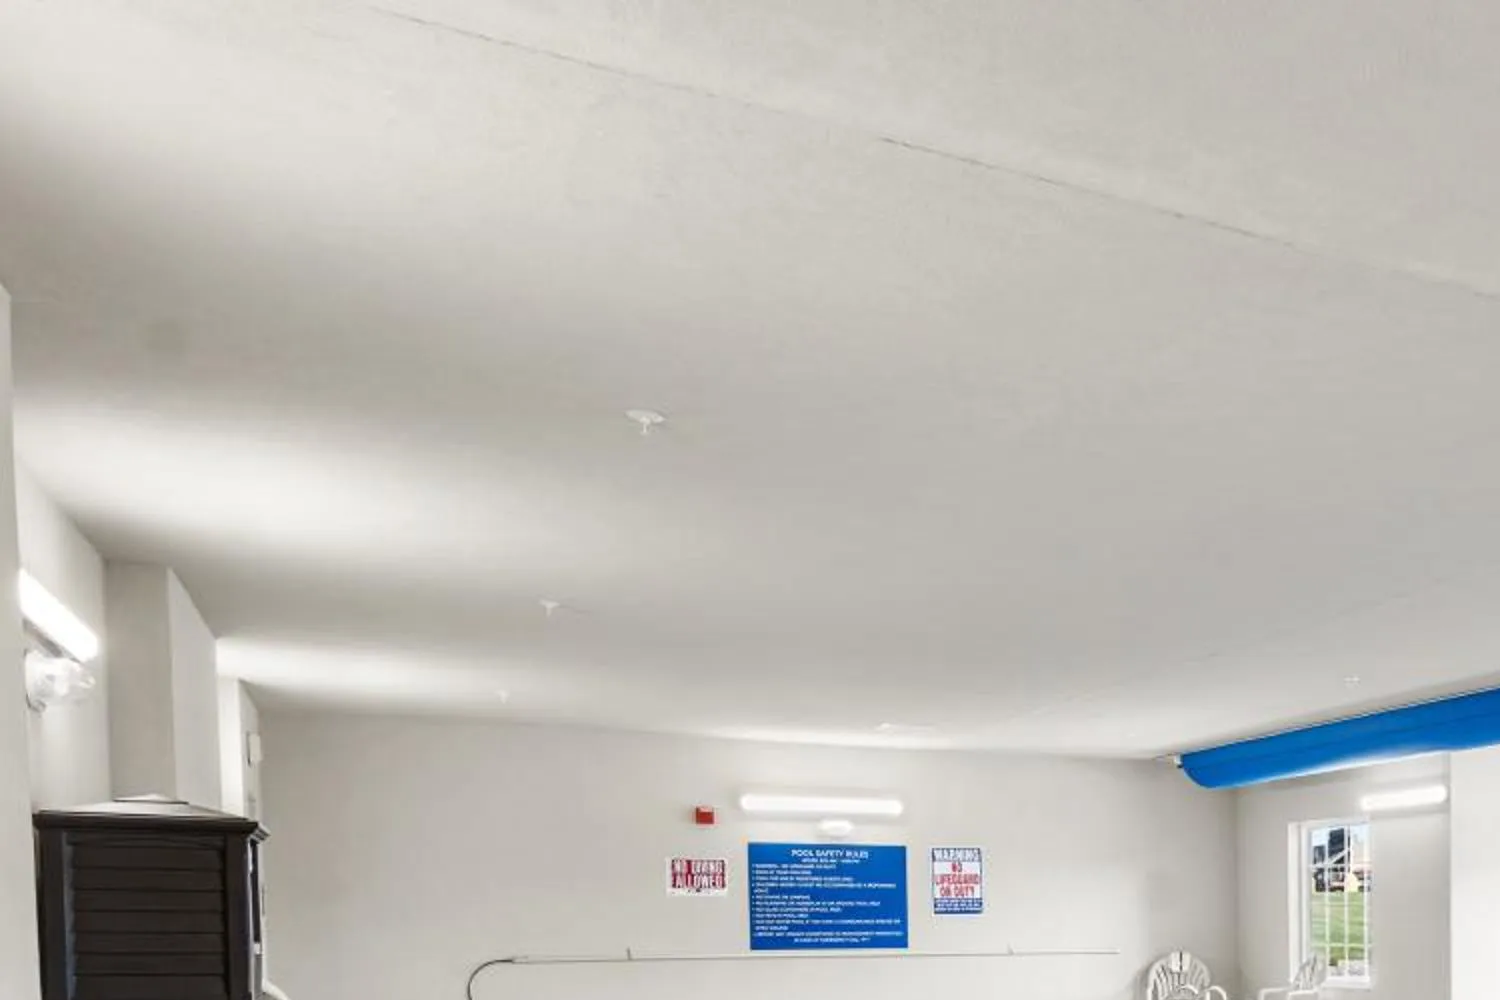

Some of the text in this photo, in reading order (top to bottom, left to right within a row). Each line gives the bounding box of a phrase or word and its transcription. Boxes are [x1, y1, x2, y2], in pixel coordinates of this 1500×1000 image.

[791, 849, 869, 859] POOL SAFETY RULES
